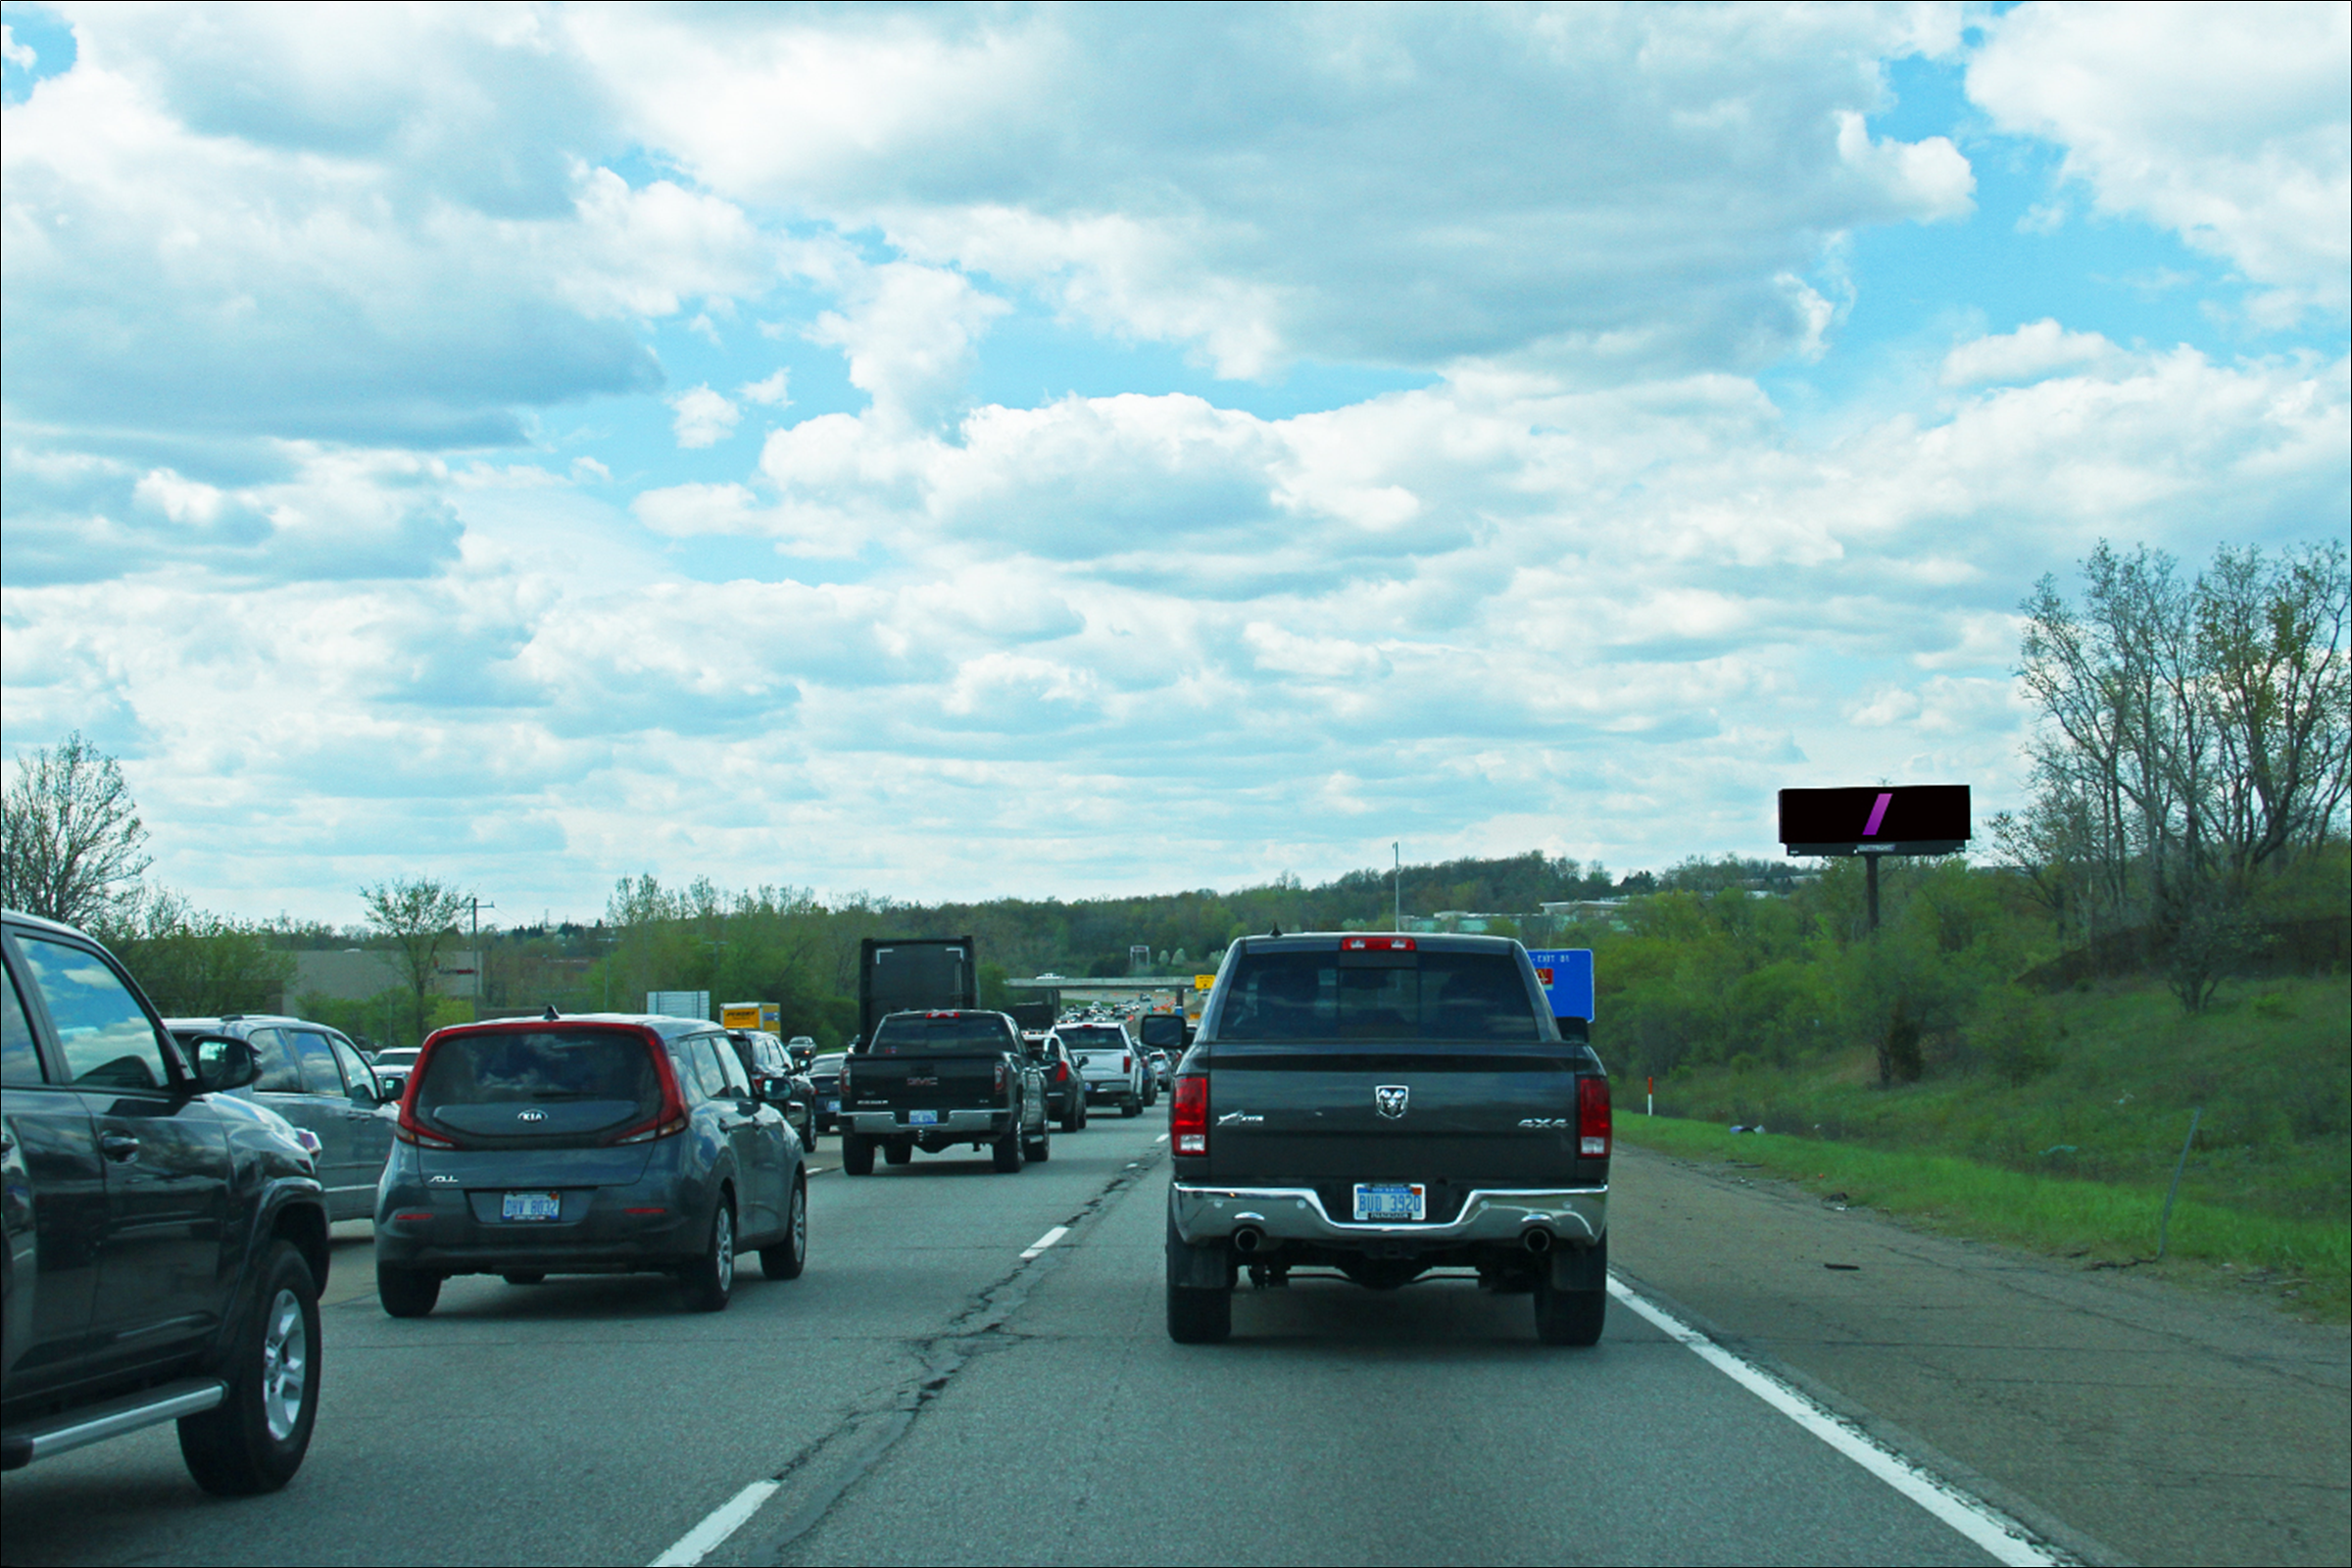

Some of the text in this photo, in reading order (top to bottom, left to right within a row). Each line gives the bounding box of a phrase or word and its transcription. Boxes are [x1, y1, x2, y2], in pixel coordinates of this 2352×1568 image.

[907, 1077, 938, 1086] GMC
[1358, 1195, 1422, 1212] BUD 3920
